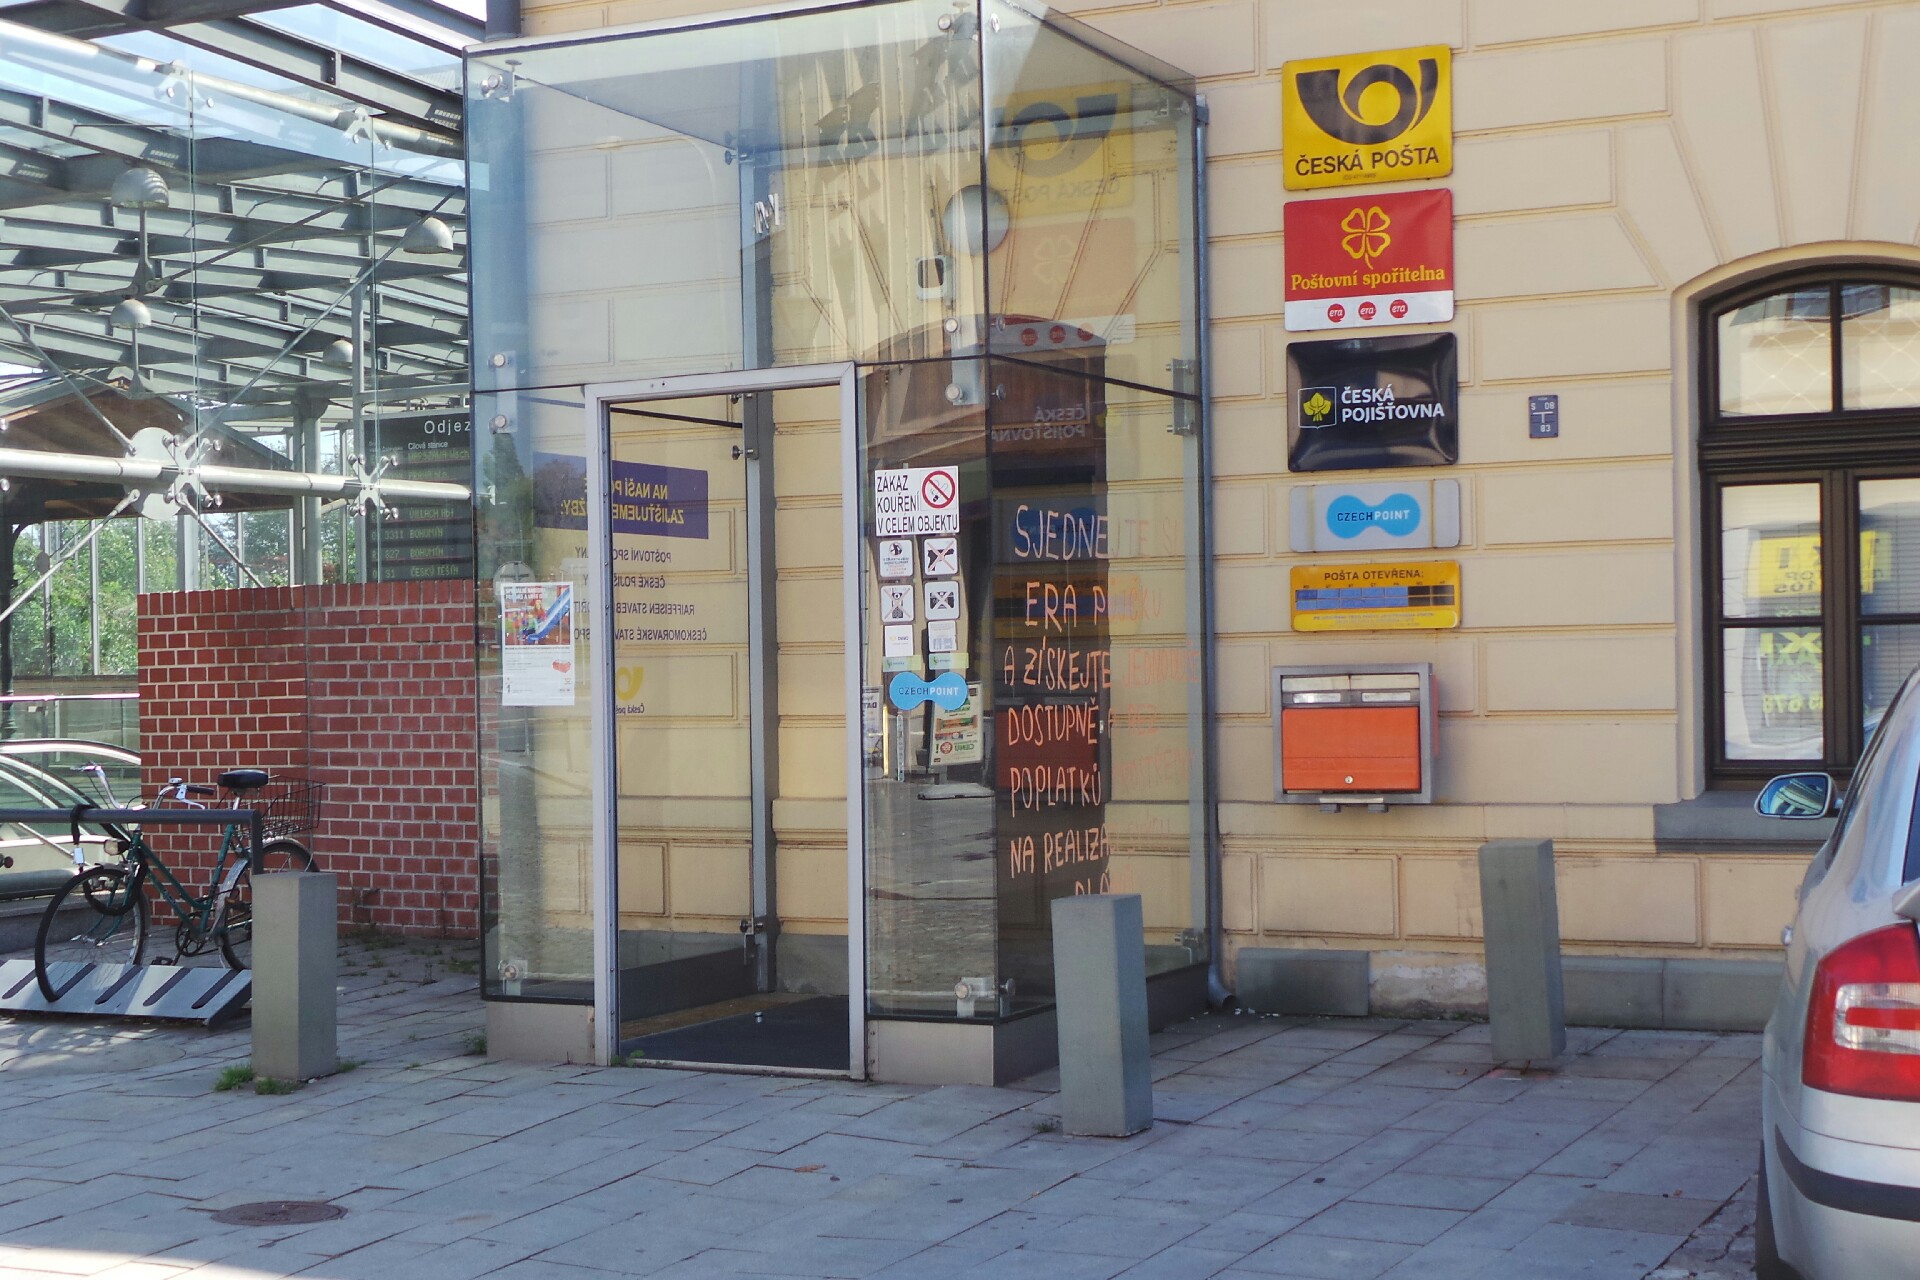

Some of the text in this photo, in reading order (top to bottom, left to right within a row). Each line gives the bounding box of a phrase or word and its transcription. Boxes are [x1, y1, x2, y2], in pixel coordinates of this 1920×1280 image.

[1295, 144, 1440, 177] ČESKÁ POŠTA
[1291, 264, 1446, 291] Poštovní spořitelna
[1329, 308, 1344, 318] era
[1360, 306, 1375, 315] era
[1391, 304, 1406, 313] era
[1341, 384, 1395, 404] ČESKÁ
[1341, 402, 1446, 424] POJIŠŤOVNA
[877, 472, 909, 493] ZÁKAZ
[877, 491, 920, 514] KOUŘENÍ
[878, 512, 958, 534] V CELÉM OBJEKTU
[1324, 568, 1425, 581] POŠTA OTEVŘENA:
[1024, 581, 1077, 633] ERA
[1003, 645, 1015, 687] A
[1023, 635, 1112, 694] ZÍSKEJTE
[1008, 696, 1100, 747] DOSTUPNĚ
[1010, 762, 1102, 818] POPLATKŮ
[1010, 836, 1035, 880] NA
